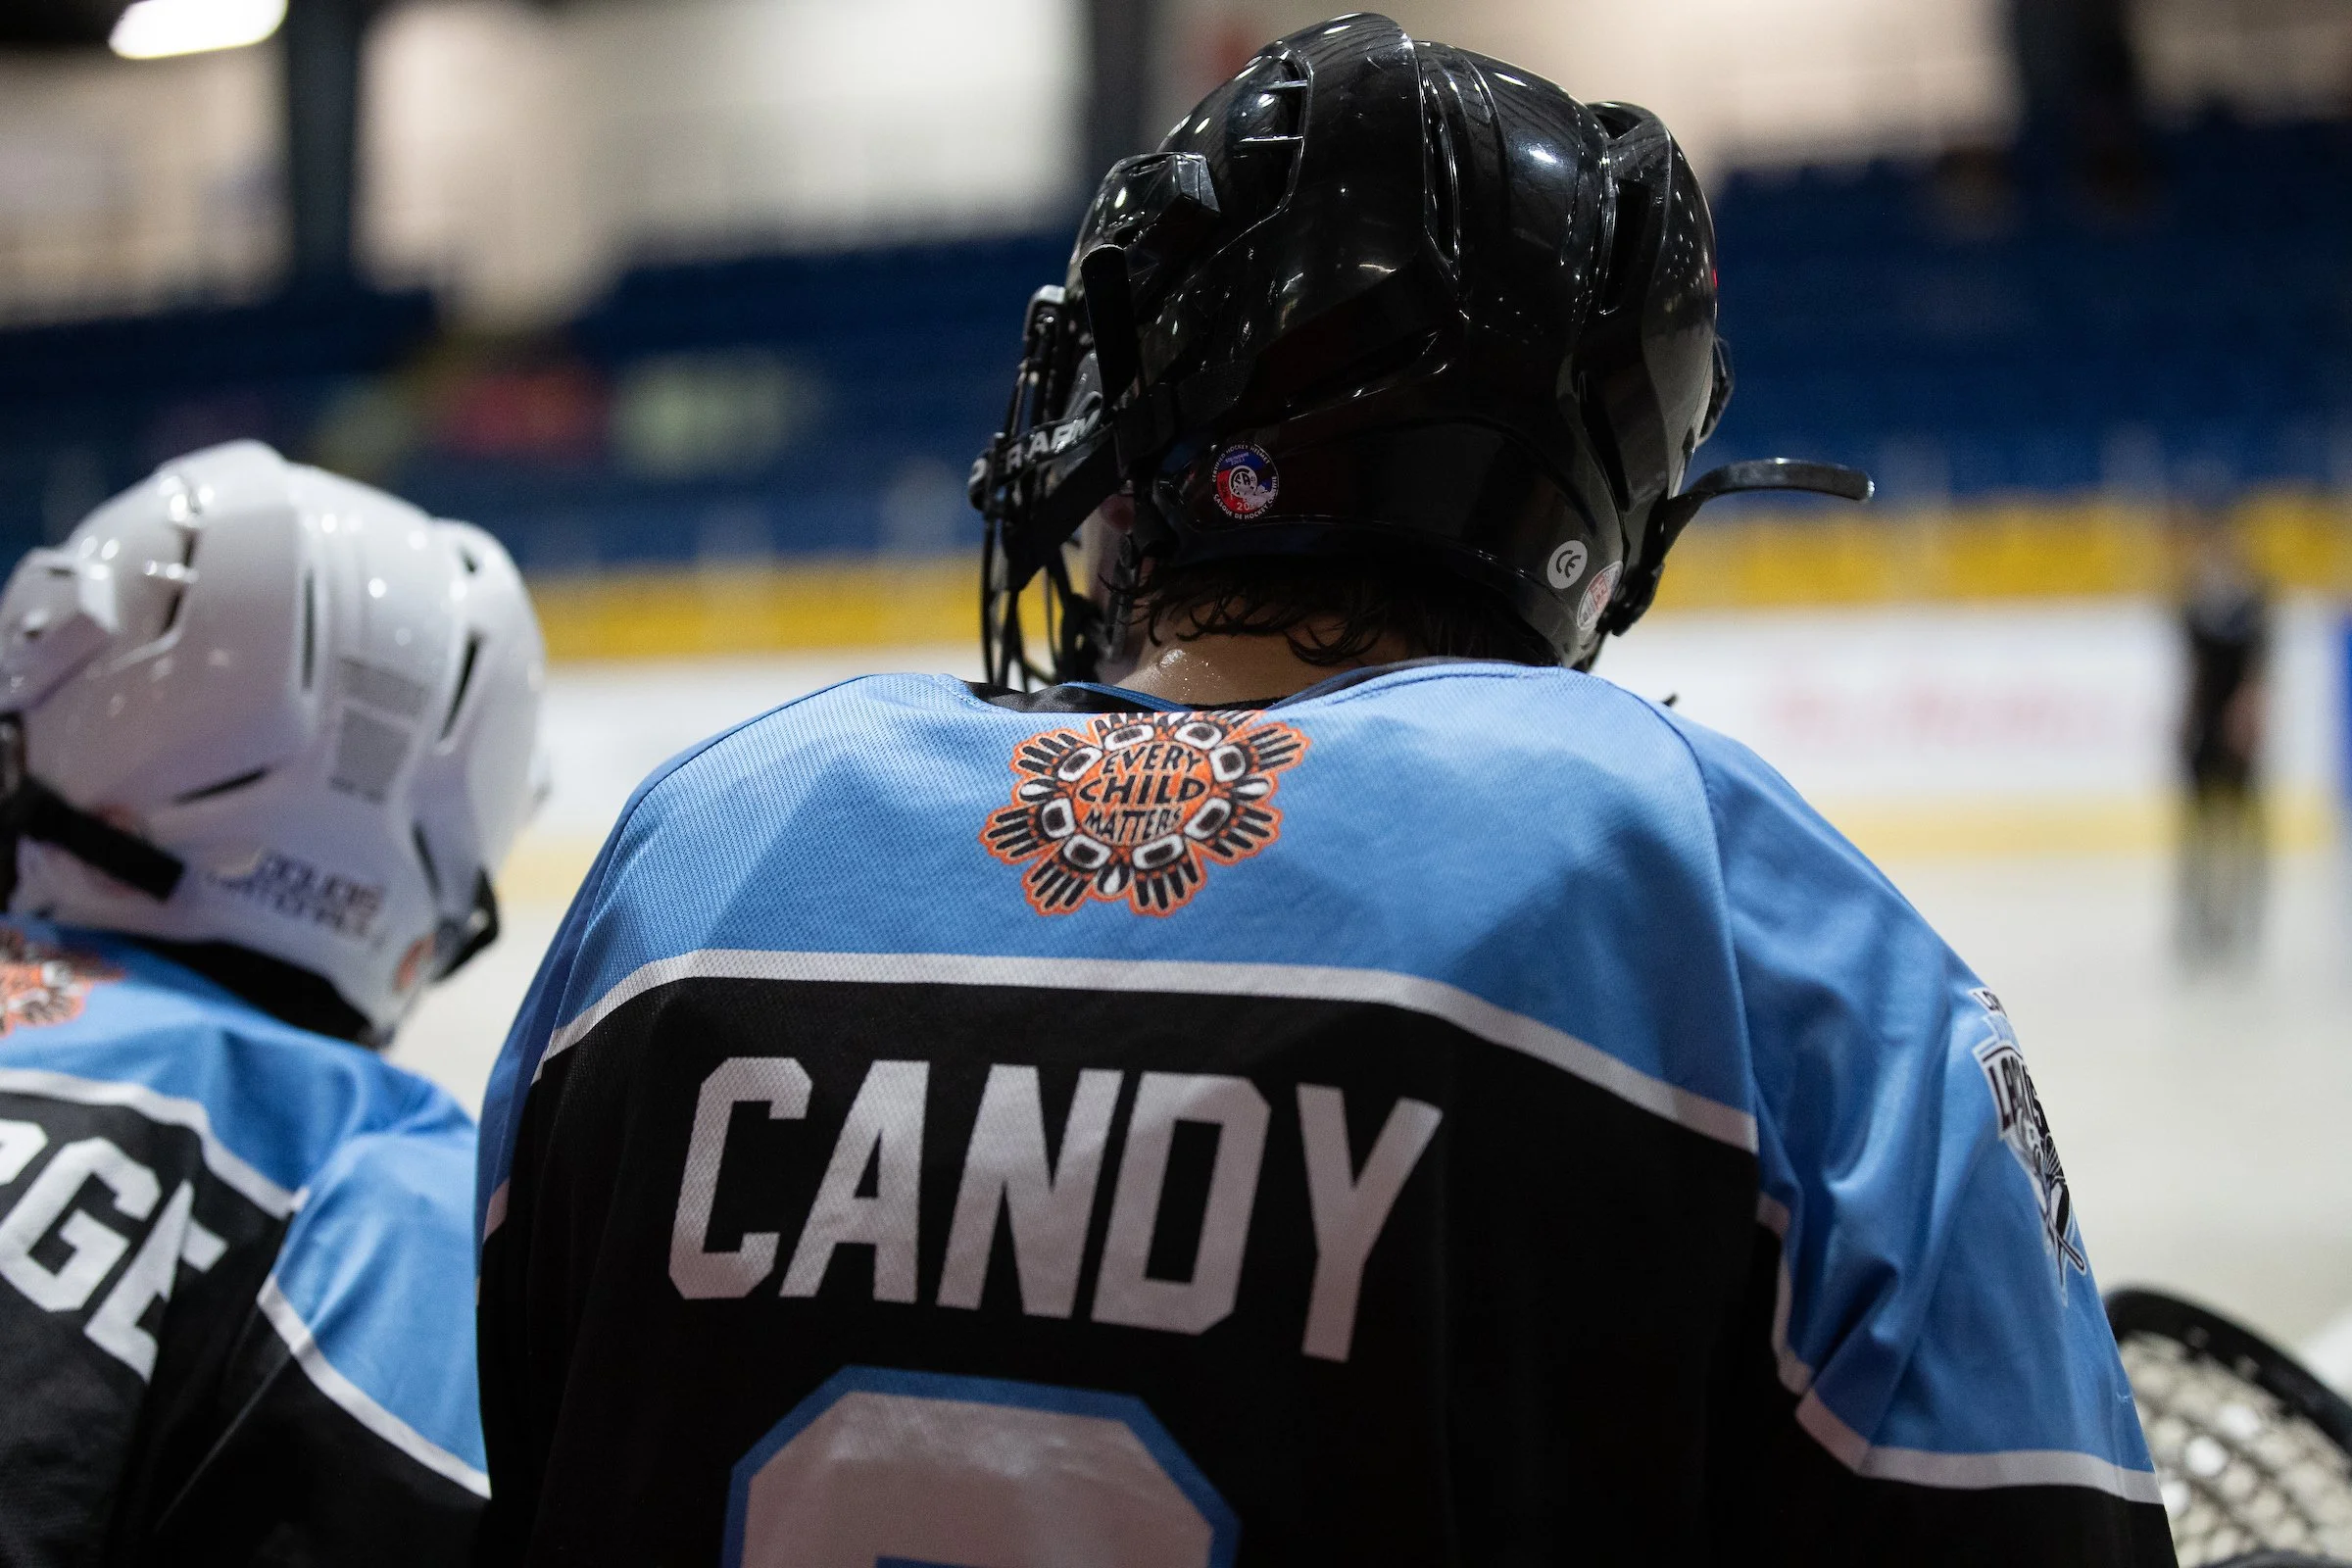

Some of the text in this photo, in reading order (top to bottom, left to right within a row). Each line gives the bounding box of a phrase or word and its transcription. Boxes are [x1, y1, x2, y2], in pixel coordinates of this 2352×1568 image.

[1226, 444, 1249, 454] HOCKEY
[1213, 493, 1234, 517] CASQUE
[1244, 503, 1269, 520] HOCKEY
[1556, 550, 1582, 578] CE
[1102, 744, 1202, 774] EVERY
[1079, 774, 1206, 805] CHILD
[1085, 808, 1183, 843] MATTERS
[668, 1056, 1444, 1362] CANDY
[0, 1119, 229, 1386] GE
